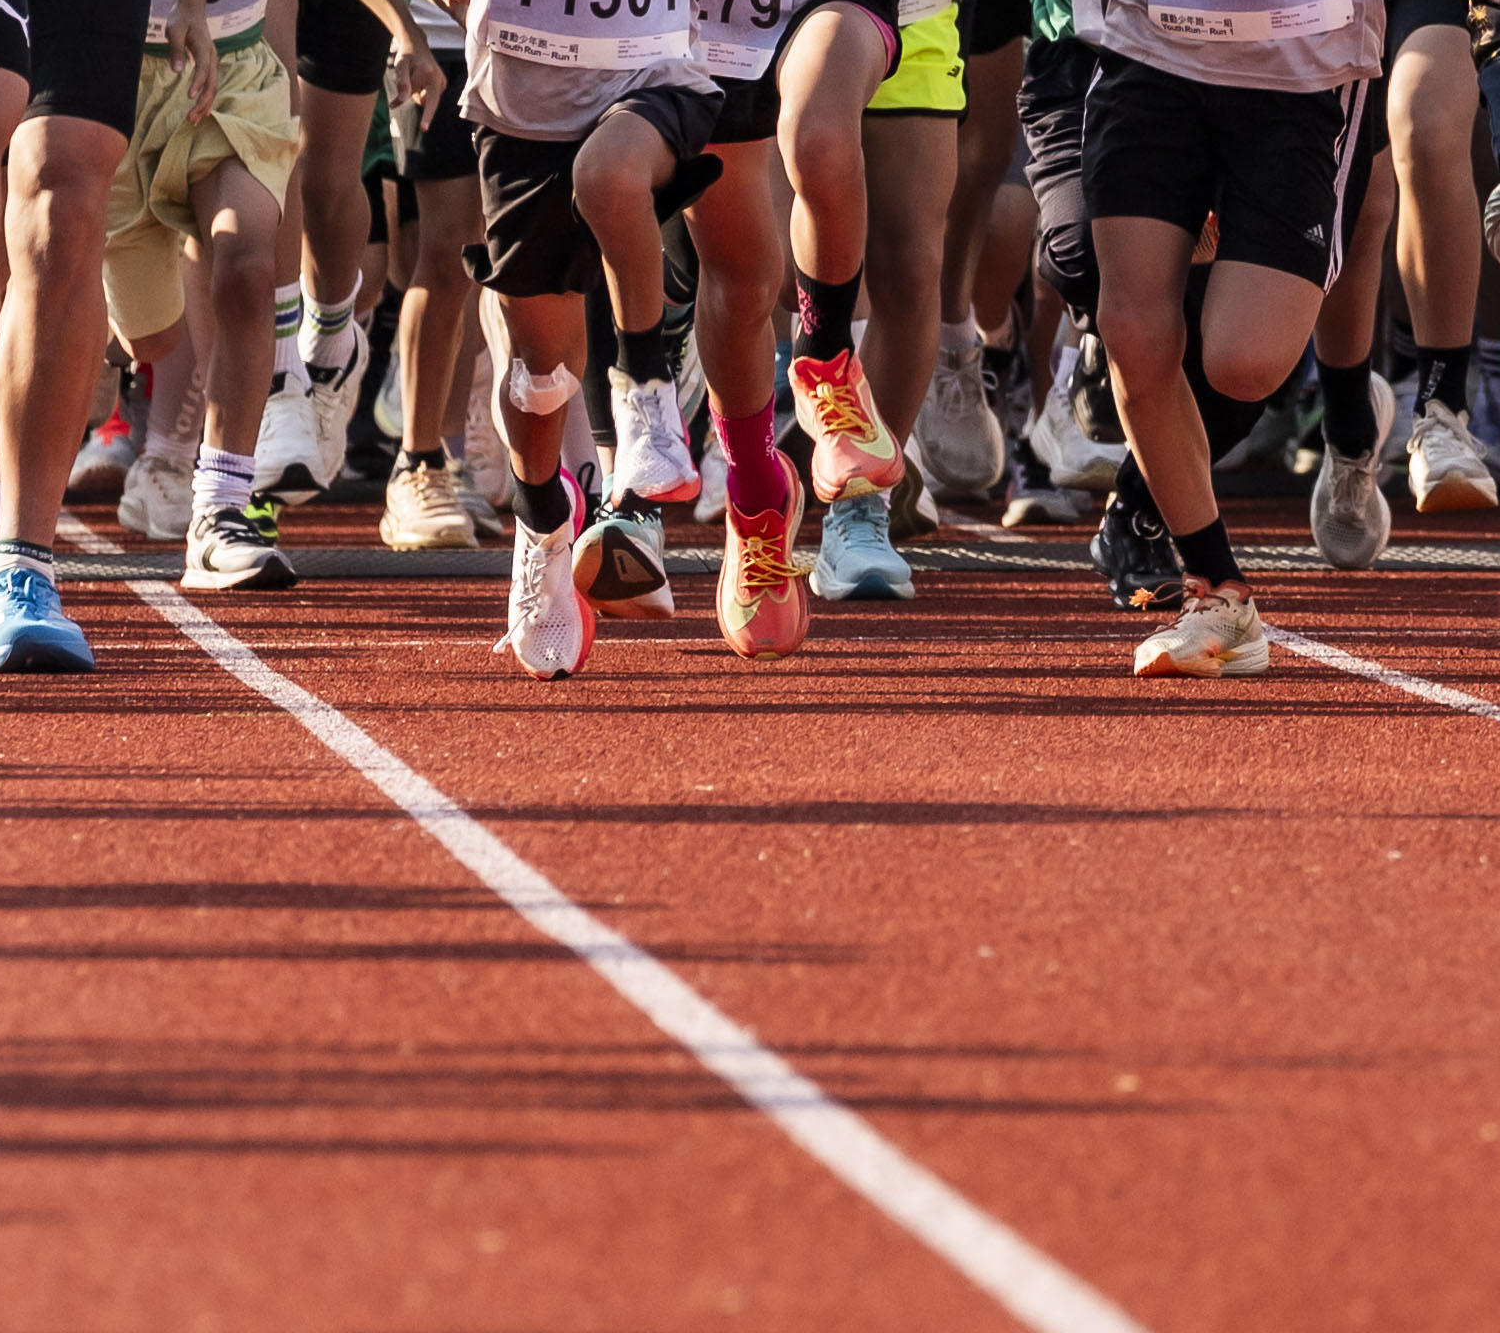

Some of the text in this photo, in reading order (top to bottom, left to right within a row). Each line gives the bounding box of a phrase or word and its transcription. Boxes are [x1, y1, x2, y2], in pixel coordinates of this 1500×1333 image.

[1161, 22, 1183, 34] Youth
[1184, 25, 1201, 35] Run
[1209, 27, 1227, 36] Run
[499, 40, 579, 62] Youth Run Run 1
